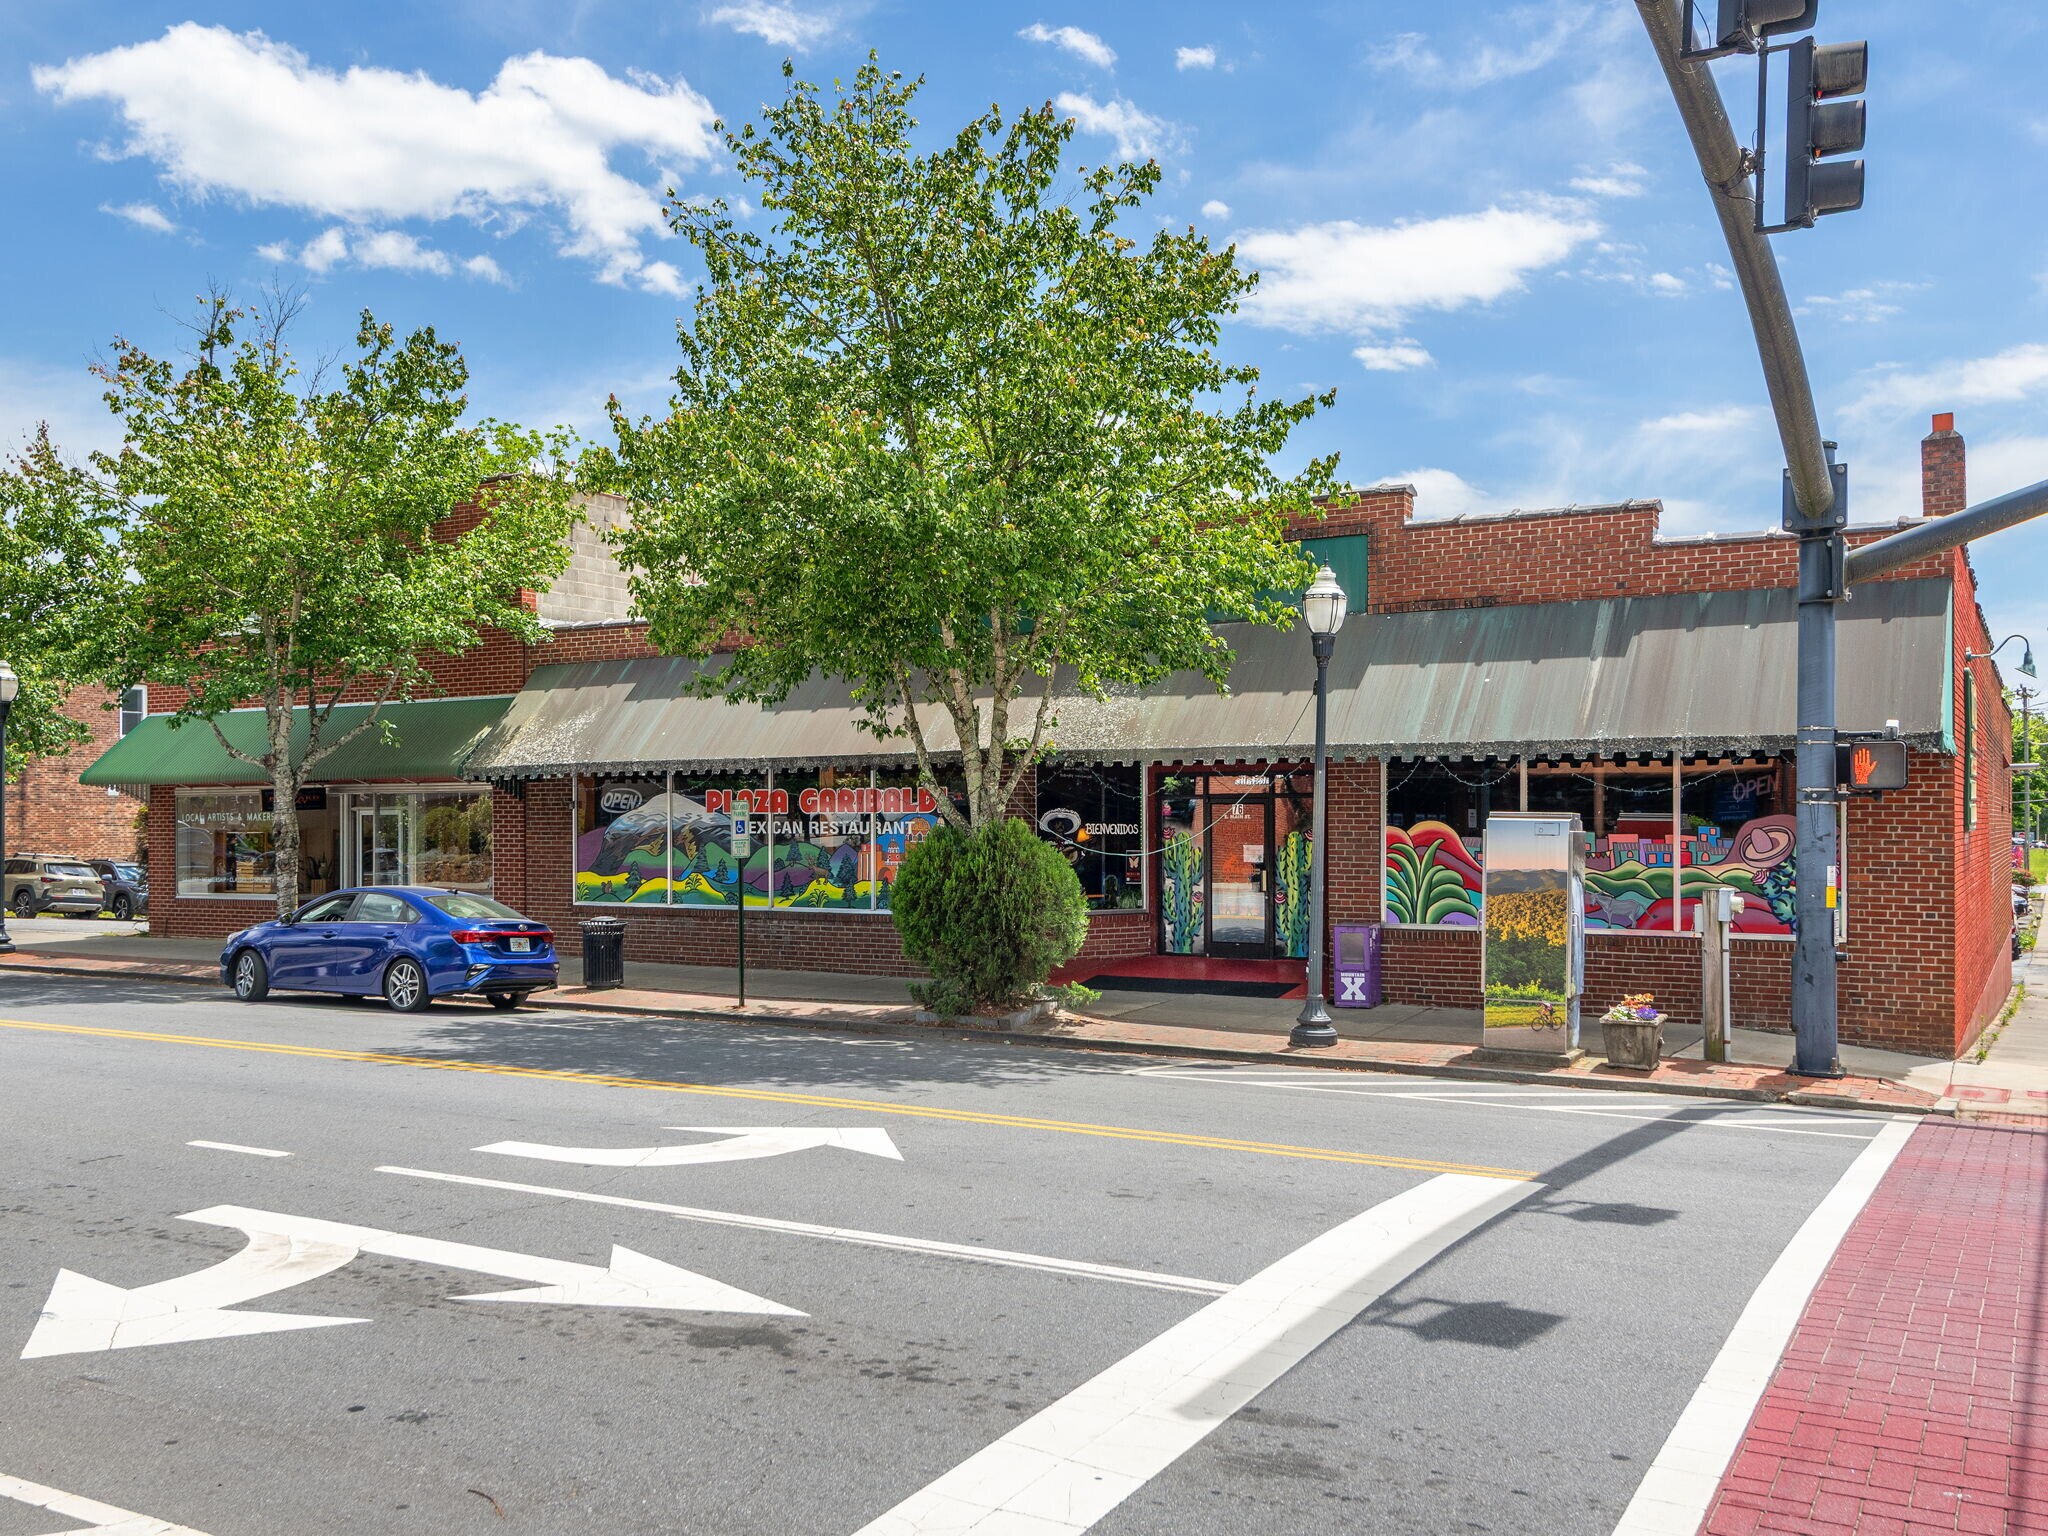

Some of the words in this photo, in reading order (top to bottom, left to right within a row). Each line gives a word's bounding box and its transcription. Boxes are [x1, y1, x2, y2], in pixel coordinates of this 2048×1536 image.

[1732, 774, 1778, 801] OPEN
[603, 792, 638, 810] OPEN
[799, 787, 948, 814] GARIBALD
[207, 812, 234, 821] ARTISTS
[237, 812, 242, 821] &
[246, 812, 275, 821] MAKERS
[1233, 804, 1243, 814] 76
[749, 821, 803, 834] EXCAN
[809, 820, 915, 834] RESTAURANT
[1085, 823, 1139, 834] BIENVENIDOS
[1340, 977, 1366, 1000] X
